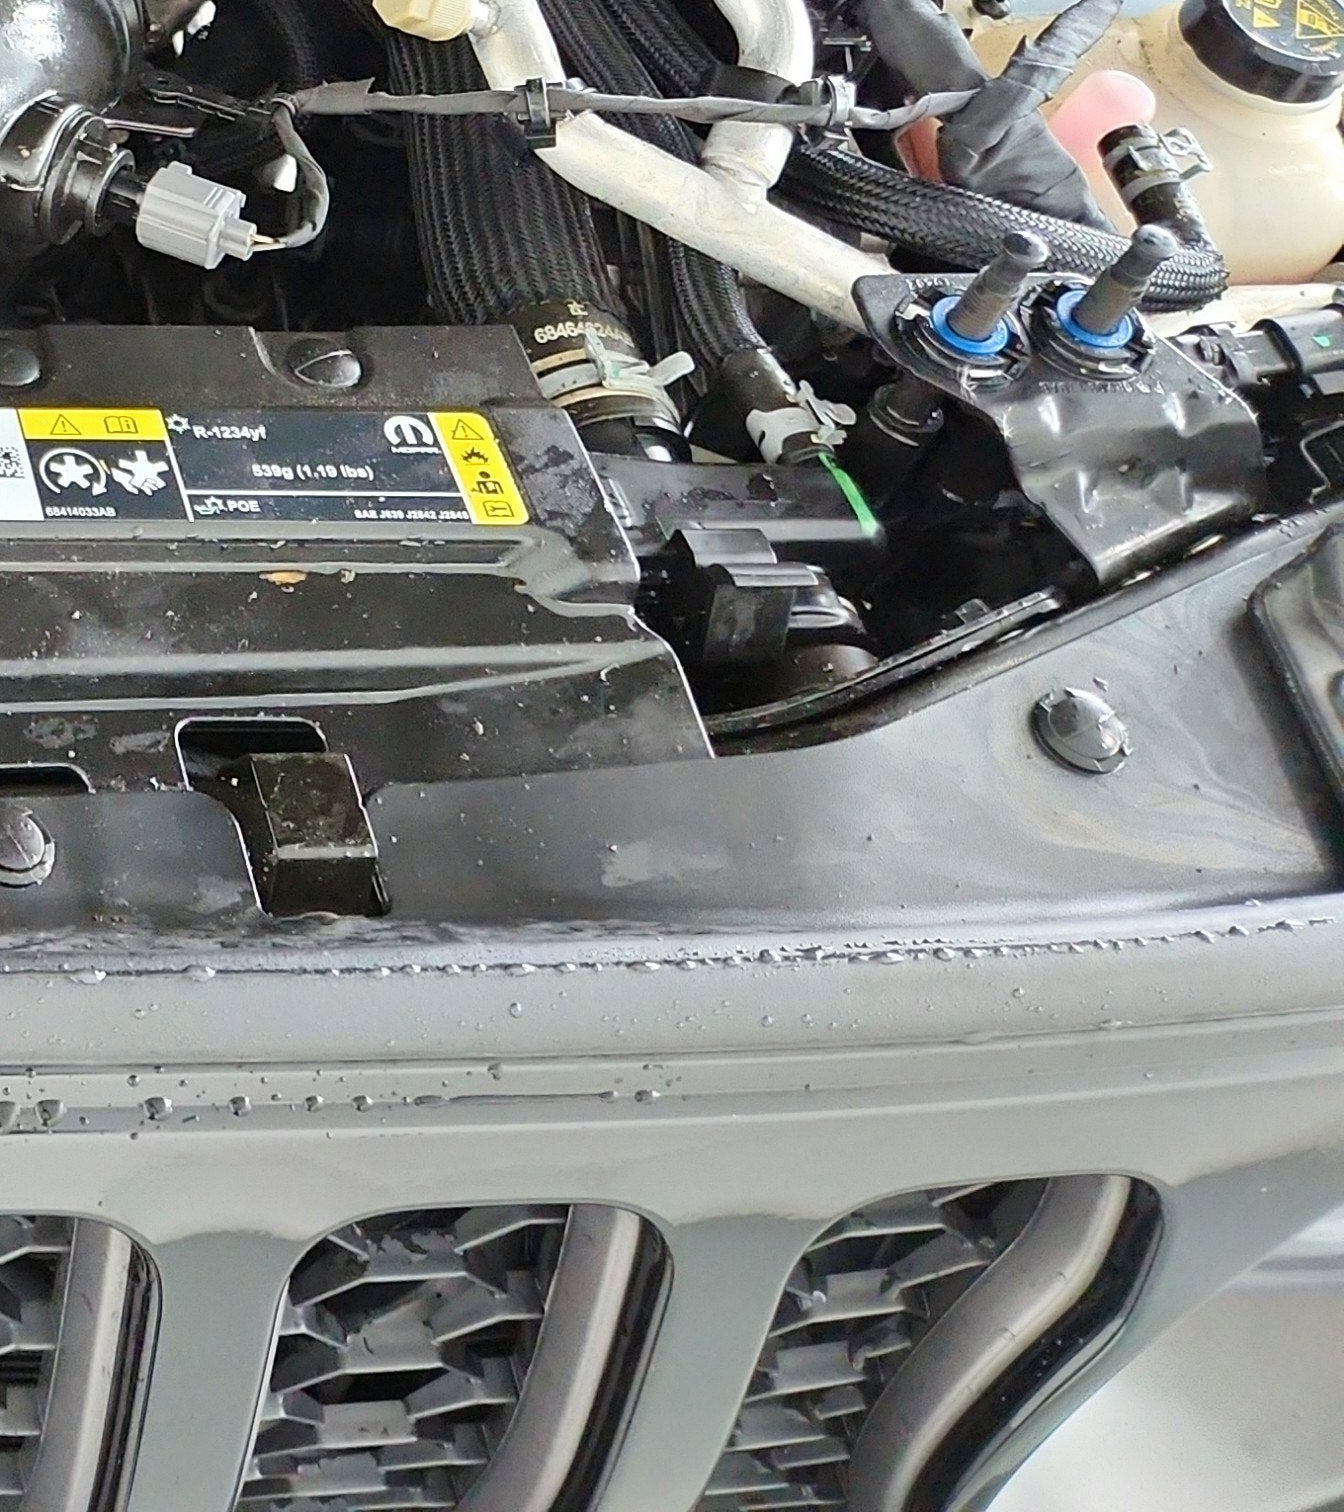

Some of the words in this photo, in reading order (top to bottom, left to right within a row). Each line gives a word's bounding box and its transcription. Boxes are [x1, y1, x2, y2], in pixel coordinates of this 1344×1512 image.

[192, 425, 267, 442] R-1234yf
[251, 464, 293, 480] 539g
[339, 464, 374, 481] lbs)
[227, 500, 261, 513] POE
